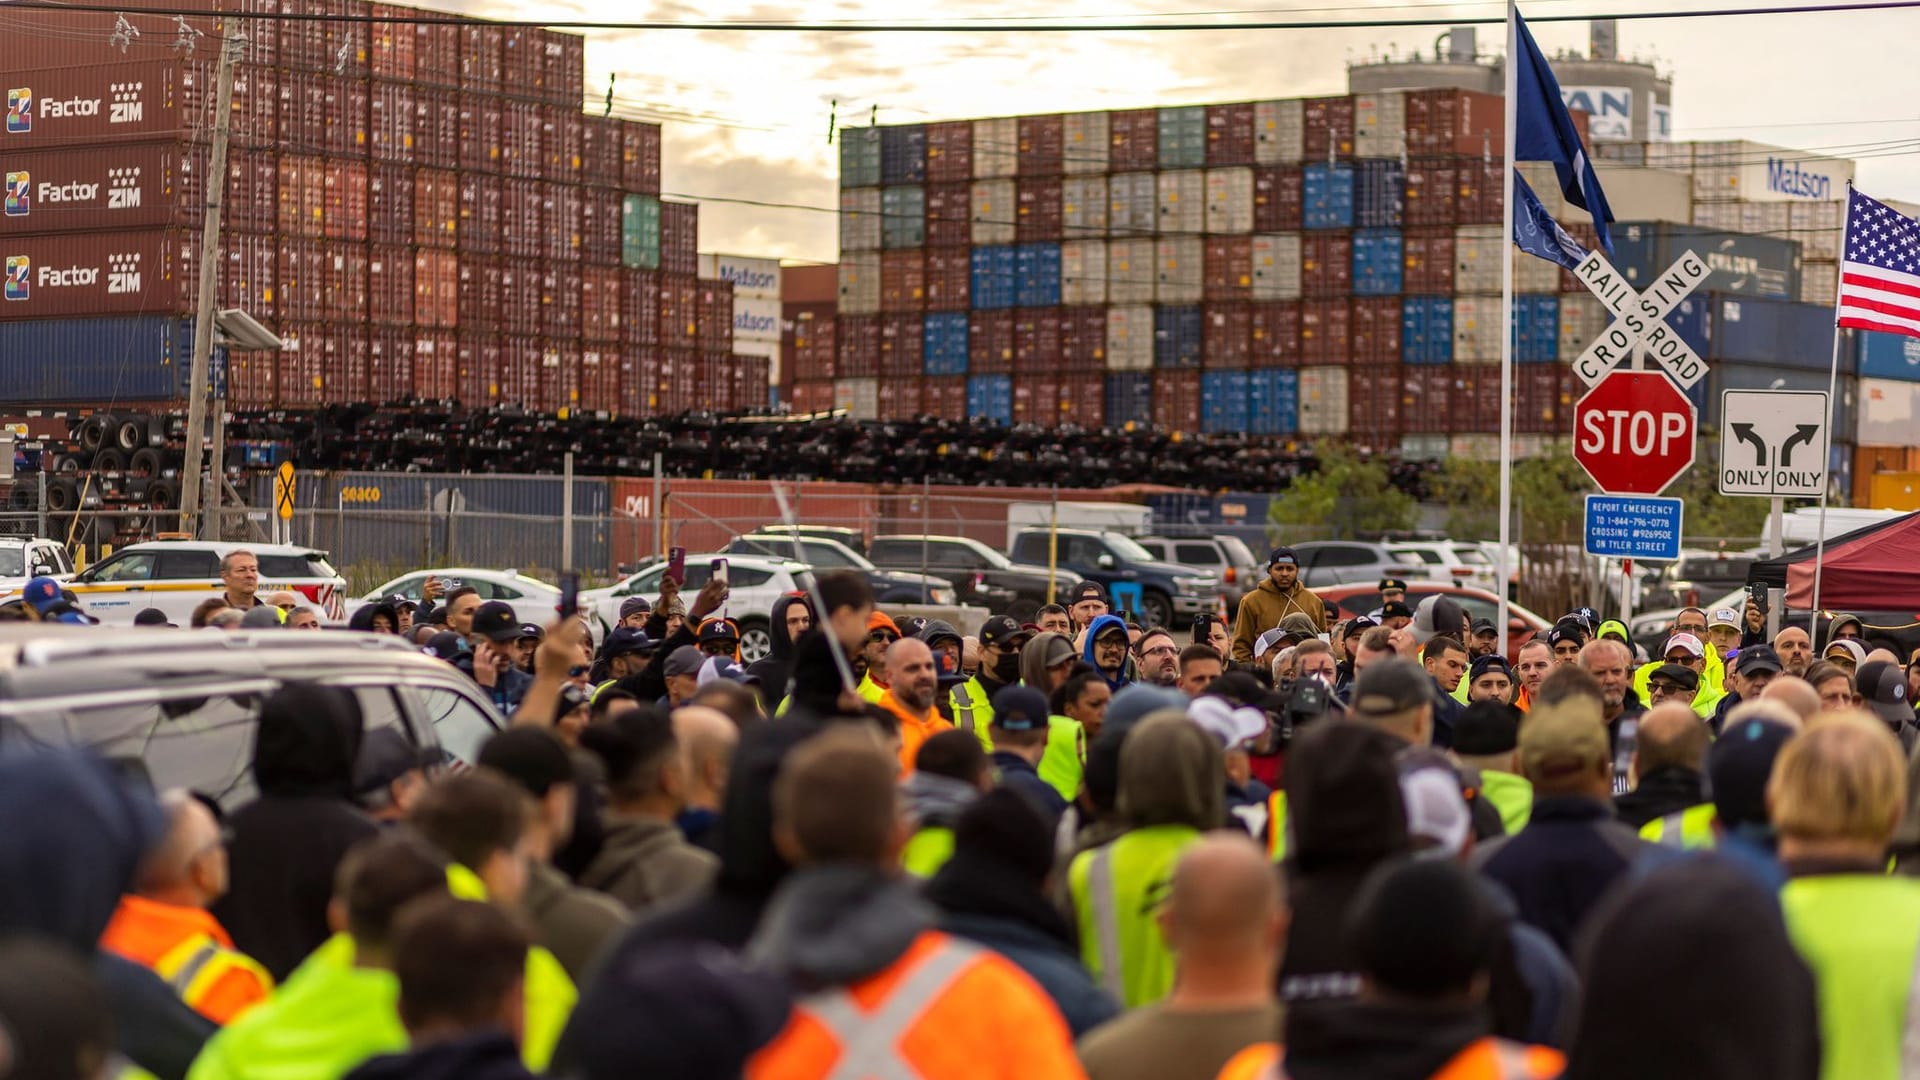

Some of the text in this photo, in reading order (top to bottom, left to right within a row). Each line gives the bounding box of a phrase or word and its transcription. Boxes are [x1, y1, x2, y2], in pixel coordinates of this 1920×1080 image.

[40, 96, 101, 118] Factor
[110, 102, 143, 123] ZIM
[1561, 90, 1628, 117] AN
[1768, 157, 1830, 199] Matson
[38, 180, 99, 203] Factor
[108, 187, 141, 209] ZIM
[38, 265, 99, 287] Factor
[108, 272, 141, 293] ZIM
[734, 309, 775, 331] atson
[1580, 258, 1699, 380] RAIL ROAD
[1580, 259, 1701, 379] CROSSING
[1581, 409, 1687, 457] STOP
[1725, 470, 1769, 485] ONLY
[1776, 471, 1821, 487] ONLY
[342, 486, 380, 502] seaco
[1592, 503, 1673, 514] REPORT EMERGENCY
[1591, 527, 1628, 537] CROSSING
[1596, 516, 1669, 527] TO 1-844-796-0778
[1595, 540, 1666, 551] ON TYLER STREET
